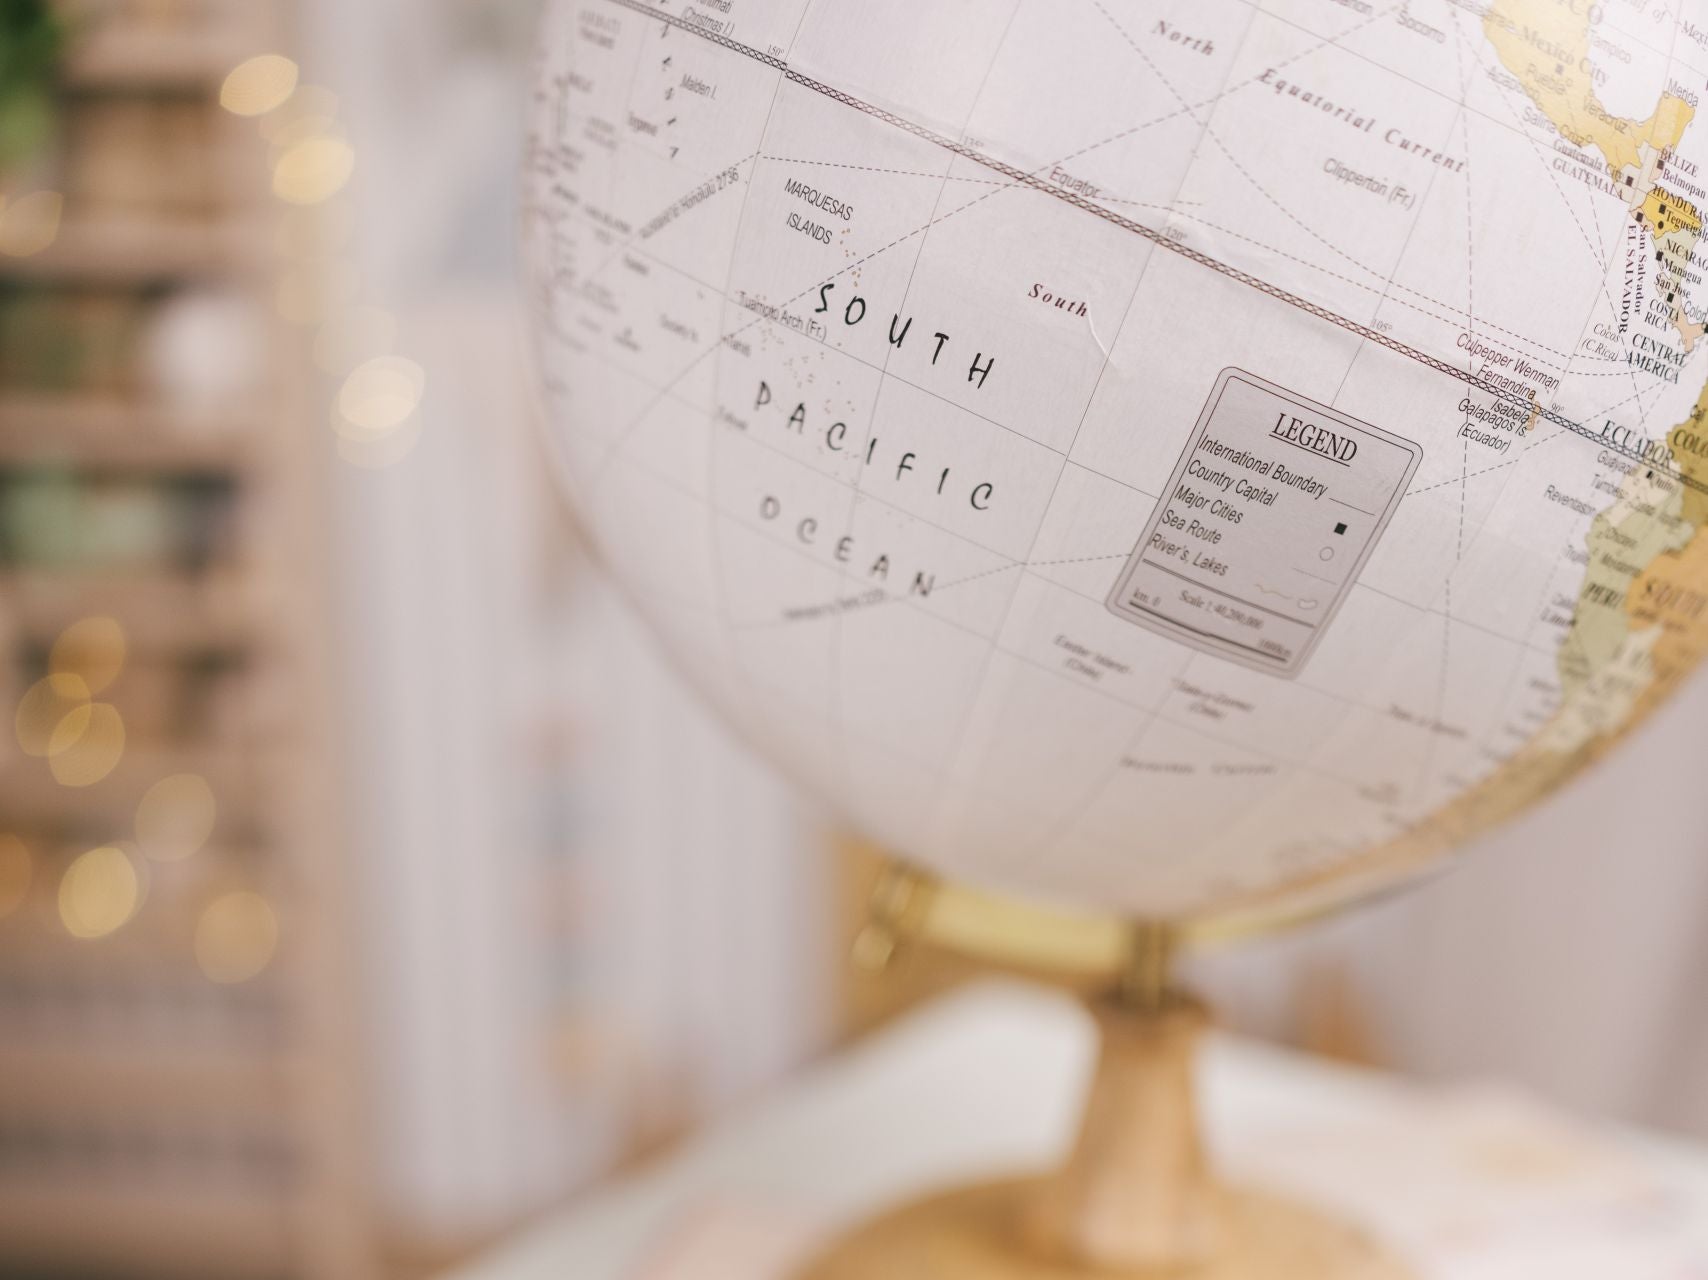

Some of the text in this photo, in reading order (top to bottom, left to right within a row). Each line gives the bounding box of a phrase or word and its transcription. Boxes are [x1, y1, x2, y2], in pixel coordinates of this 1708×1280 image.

[1151, 20, 1466, 174] North Equatorial Current
[1323, 156, 1388, 197] Clipperton
[1552, 157, 1624, 201] GUATEMALA
[1660, 146, 1699, 178] BELIZE
[785, 178, 853, 222] MARQUESAS
[1050, 166, 1101, 199] Equator
[1662, 168, 1706, 199] Belmopan
[1652, 184, 1708, 226] HONDURAS
[786, 212, 833, 246] ISLANDS
[1618, 225, 1637, 334] EL SALVADOR
[1634, 224, 1649, 315] San Salvador
[1654, 273, 1692, 300] San Jose
[1663, 258, 1702, 286] Managua
[1027, 283, 1089, 319] South
[1649, 298, 1680, 322] COSTA
[814, 282, 995, 389] SOUTH
[1593, 322, 1621, 343] Cocos
[1644, 311, 1668, 333] RICA
[1456, 332, 1560, 391] Culpepper Wenman
[1627, 351, 1680, 385] AMERICA
[1632, 333, 1687, 369] CENTRAL
[1476, 364, 1537, 401] Fernandina
[1457, 398, 1516, 432] Galapagos
[1490, 398, 1531, 424] Isabela
[754, 380, 993, 511] PACIFIC
[1272, 412, 1358, 463] LEGEND
[1456, 422, 1512, 455] (Ecuador)
[1601, 420, 1675, 469] ECUADOR
[1188, 459, 1280, 507] Country Capital
[1199, 434, 1328, 500] International Boundary
[1174, 484, 1244, 524] Major Cities
[1161, 509, 1223, 545] Sea Route
[759, 495, 935, 598] OCEAN
[1192, 551, 1229, 577] Lakes
